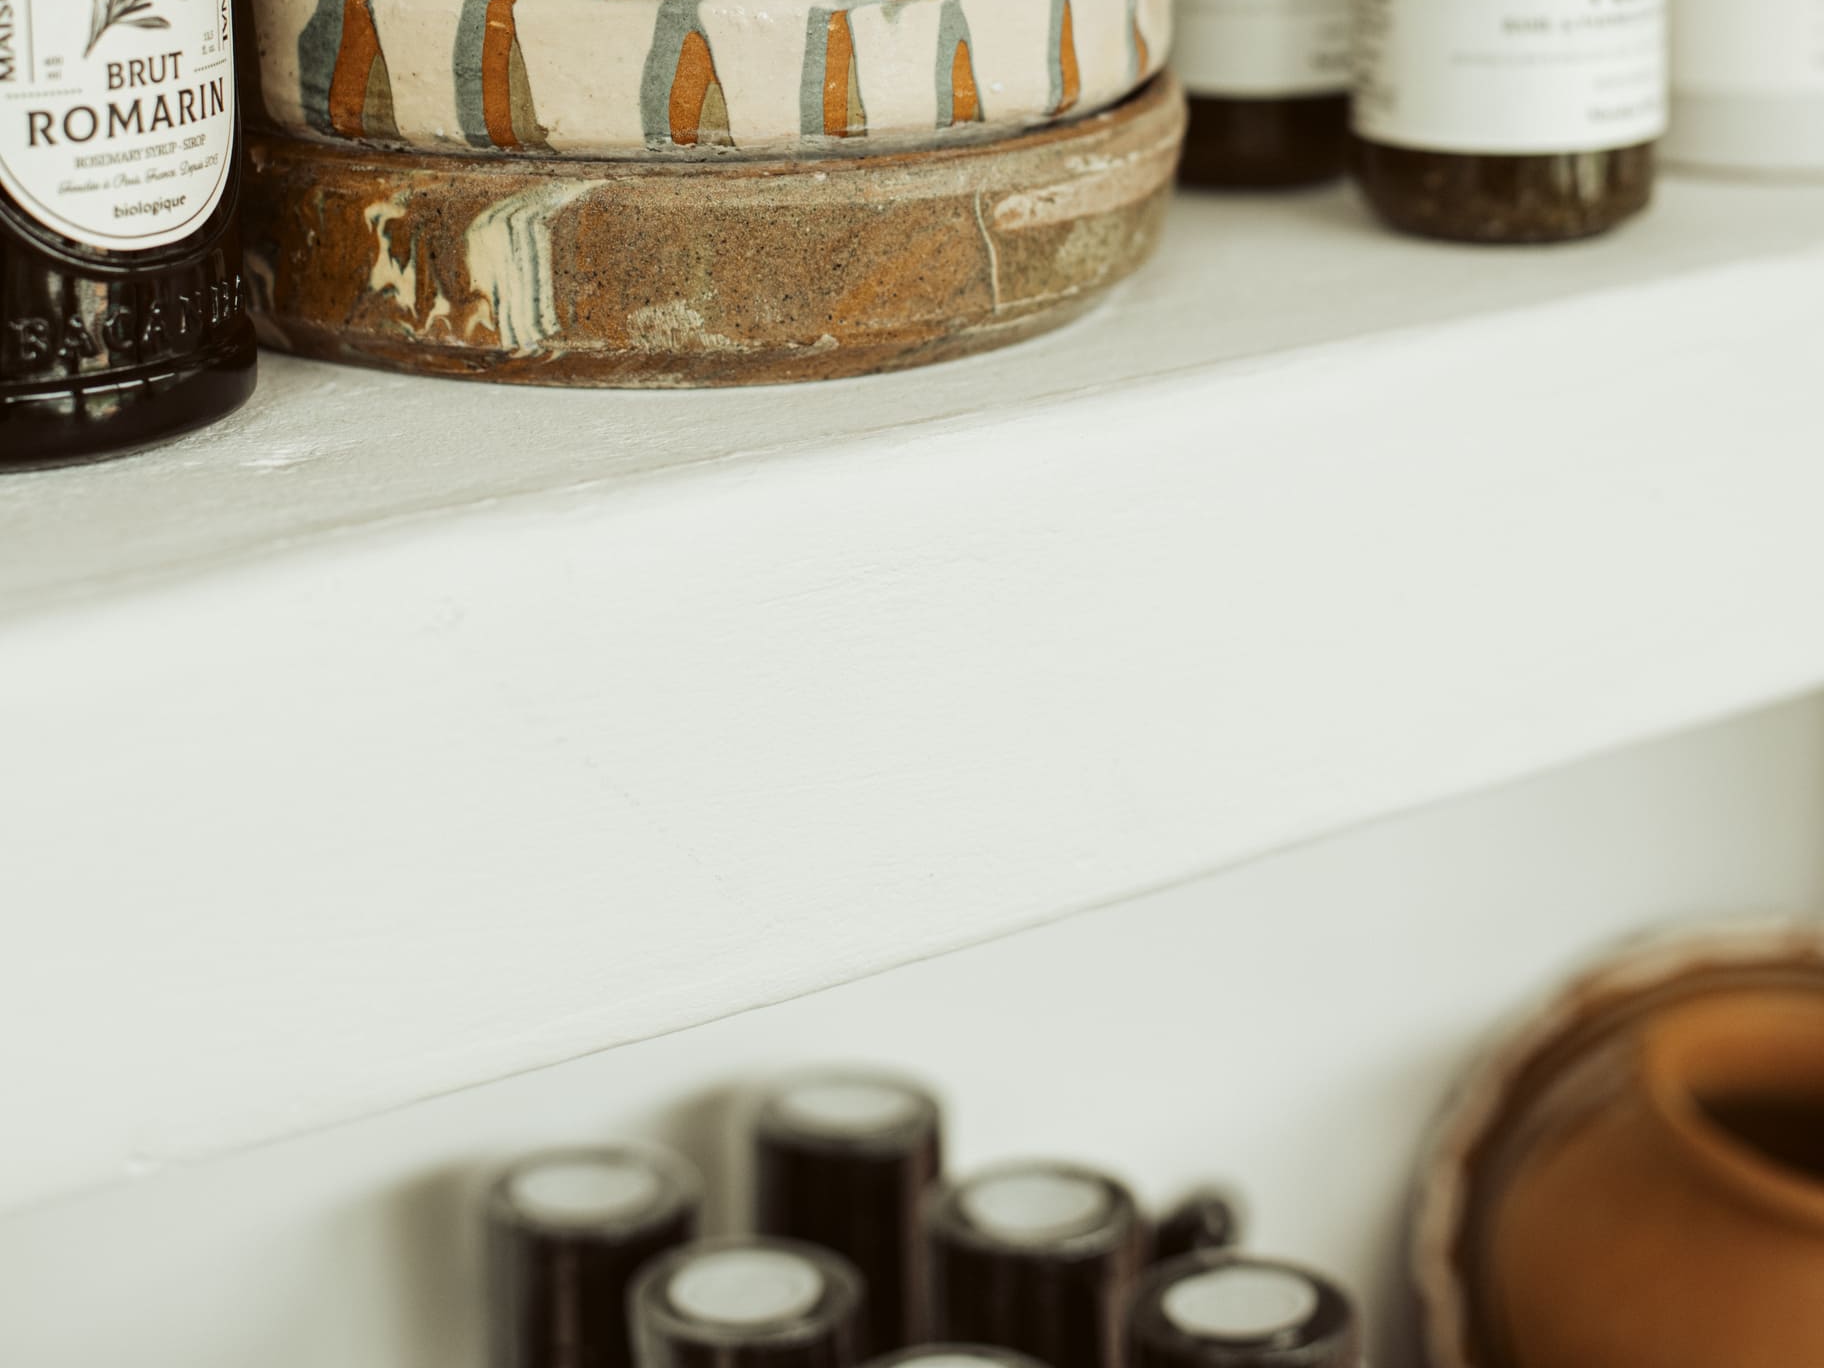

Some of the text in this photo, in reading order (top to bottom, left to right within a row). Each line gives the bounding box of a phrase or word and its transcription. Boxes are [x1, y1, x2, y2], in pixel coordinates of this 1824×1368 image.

[107, 51, 183, 91] BRUT
[27, 77, 225, 146] ROMARIN
[74, 148, 142, 169] ROSEMARY
[145, 142, 177, 159] SYRUP
[183, 134, 207, 151] SIROP
[113, 194, 187, 219] biologique
